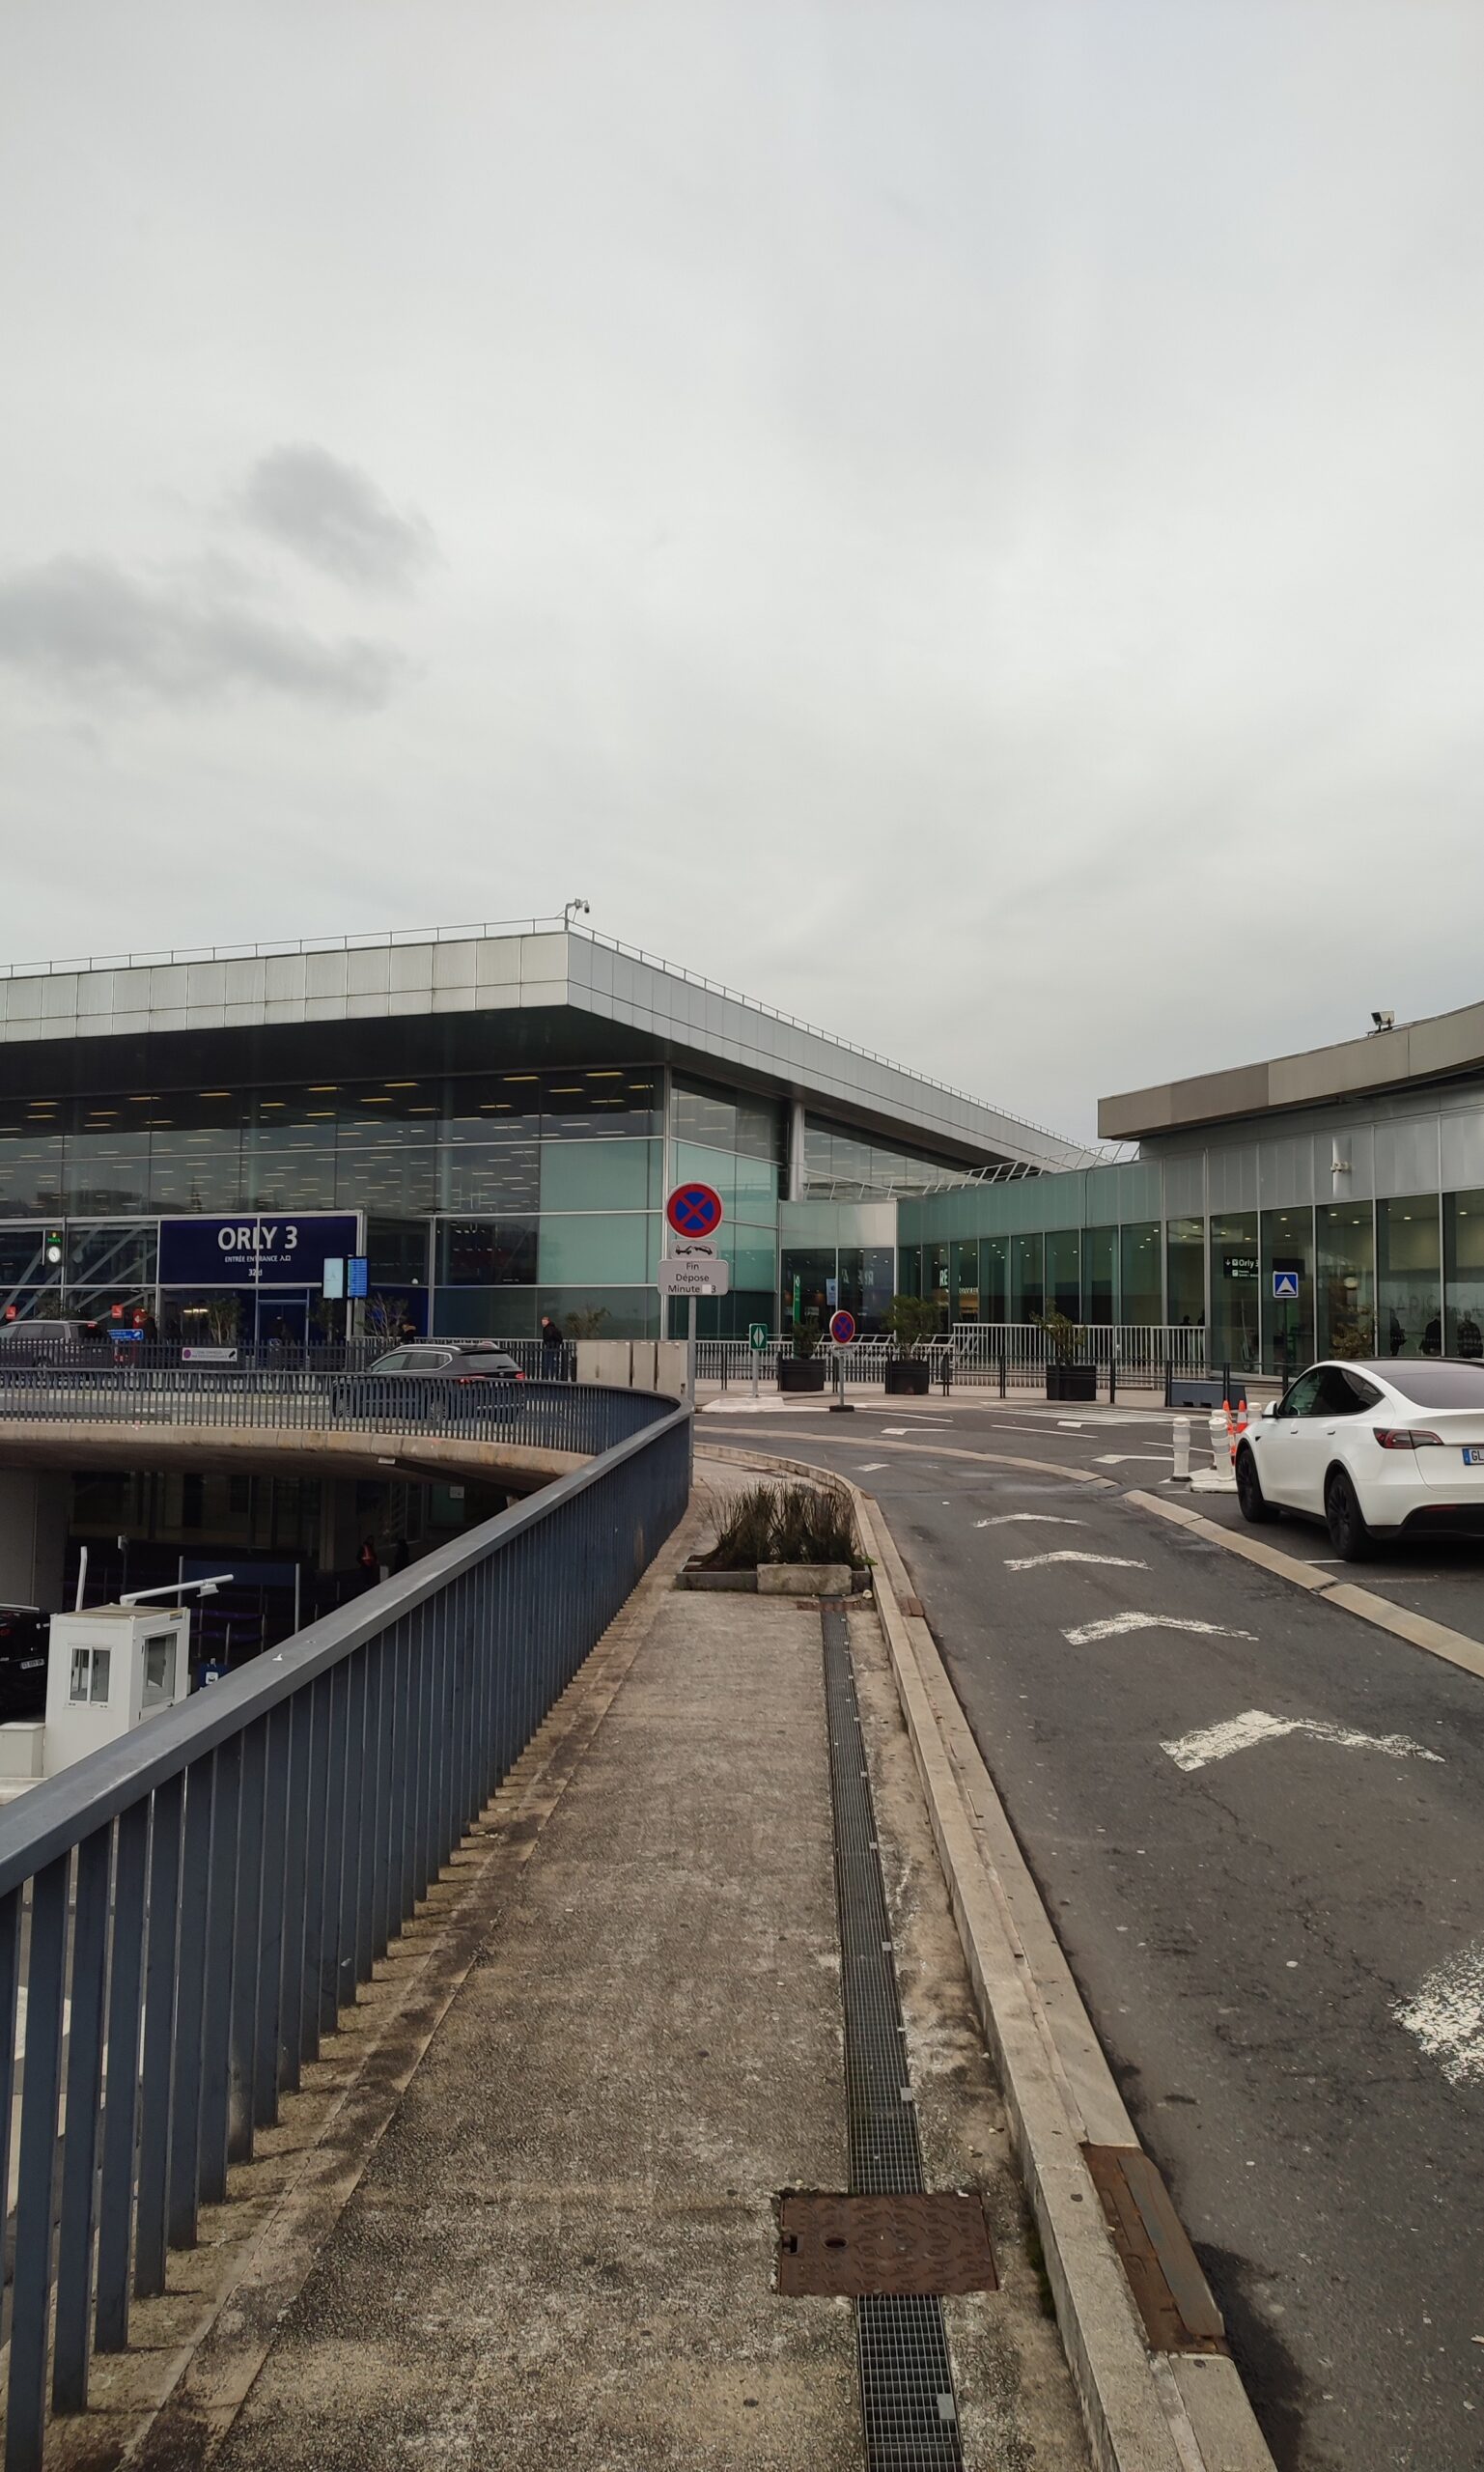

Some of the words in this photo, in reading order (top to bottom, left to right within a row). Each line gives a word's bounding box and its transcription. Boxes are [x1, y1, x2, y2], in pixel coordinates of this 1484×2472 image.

[218, 1227, 278, 1250] ORLY
[284, 1225, 297, 1250] 3
[1239, 1259, 1254, 1269] Orly
[676, 1273, 710, 1282] Dépose
[668, 1284, 700, 1293] Minute
